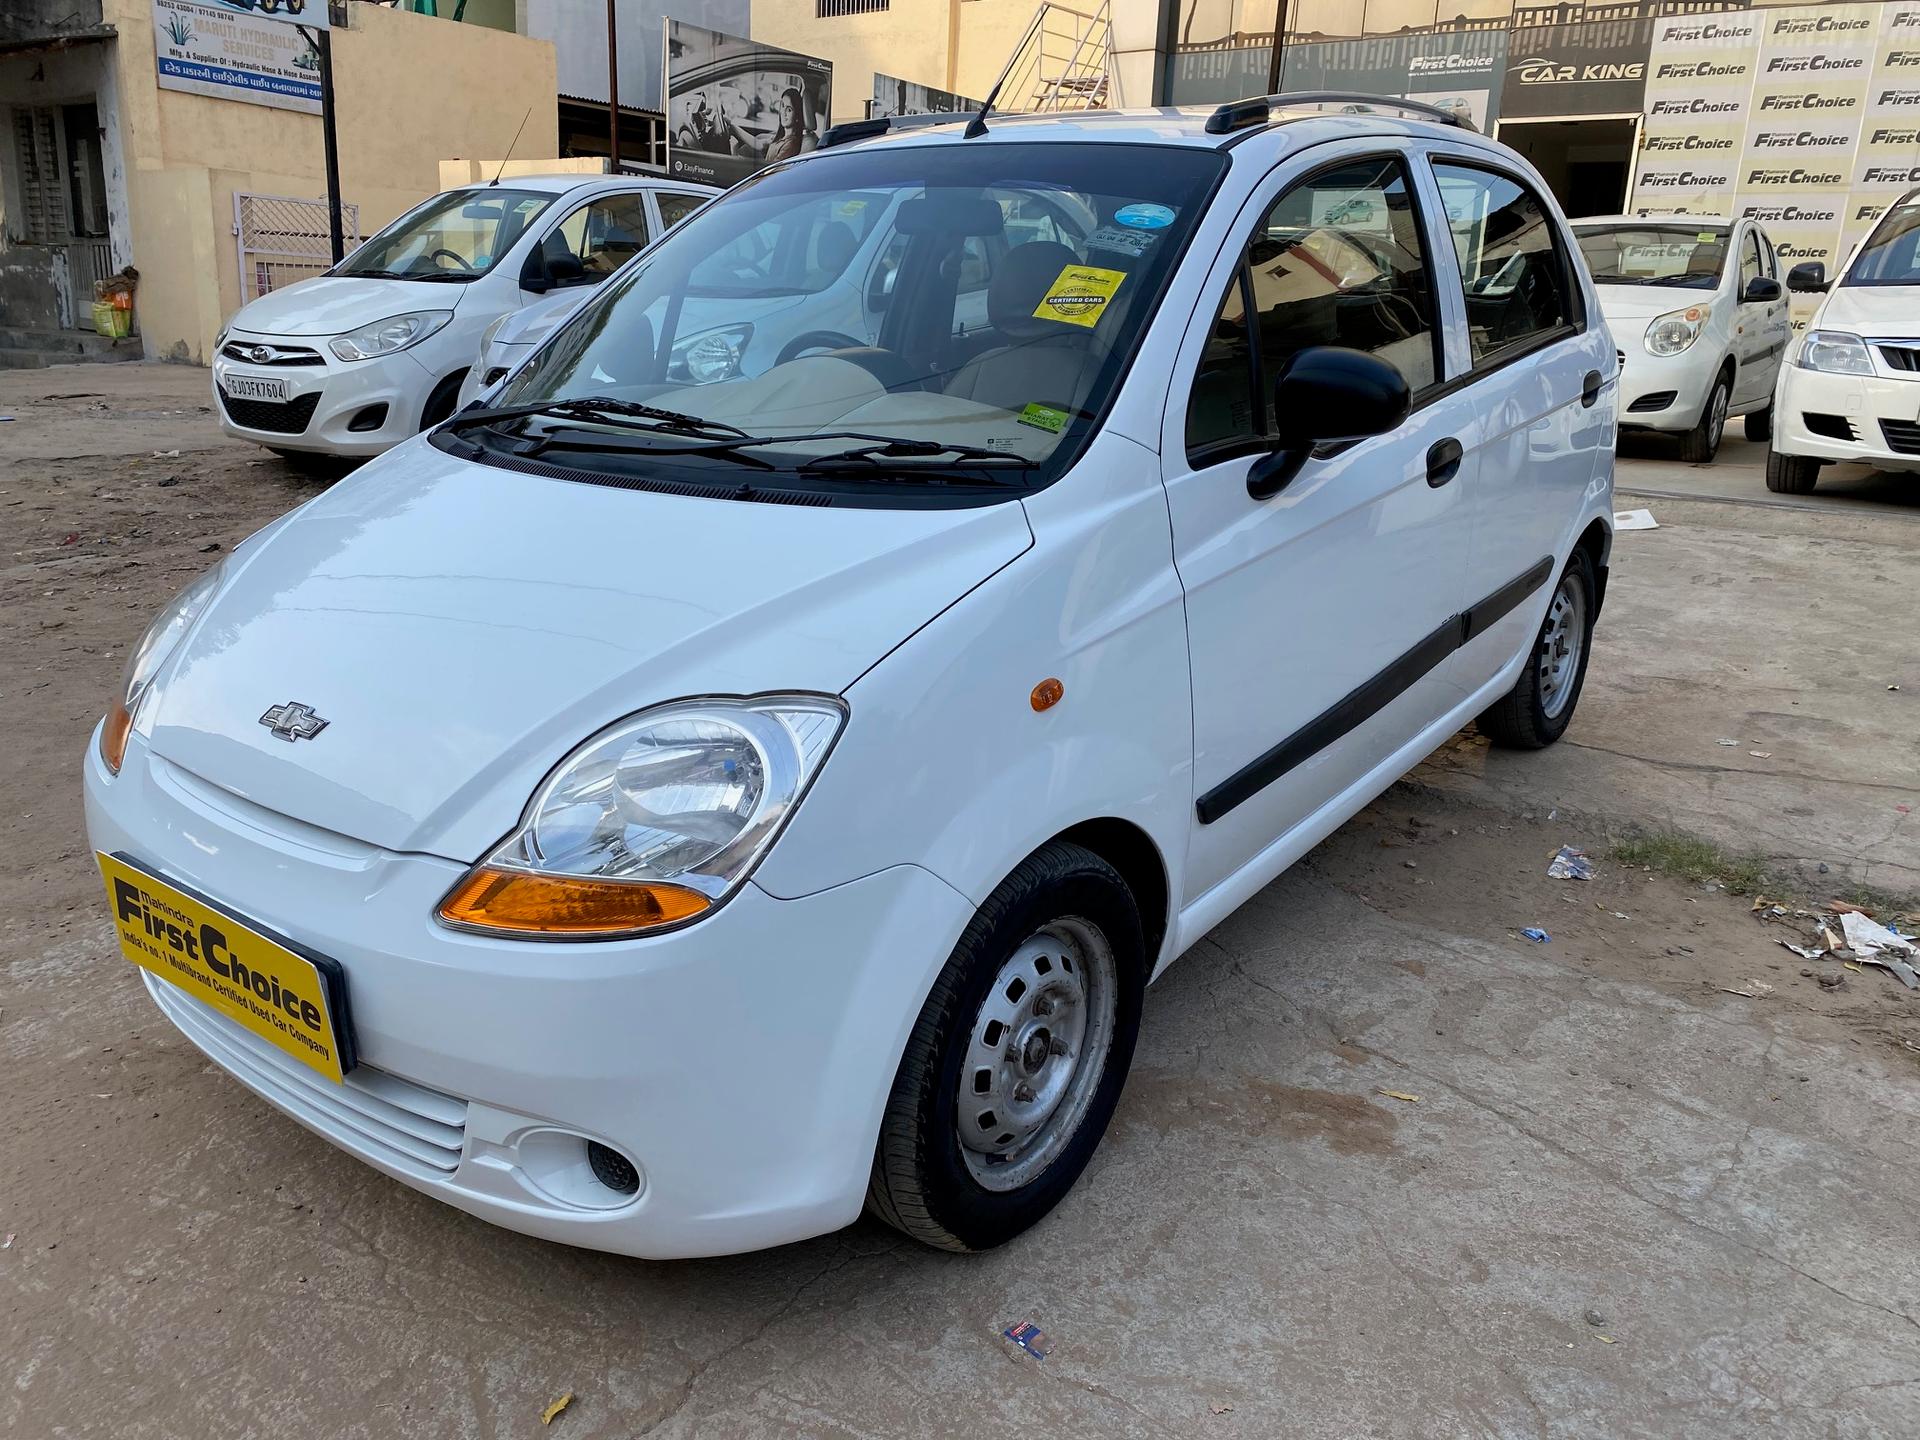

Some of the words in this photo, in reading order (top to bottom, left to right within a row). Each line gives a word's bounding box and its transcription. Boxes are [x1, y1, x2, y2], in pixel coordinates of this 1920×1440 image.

[223, 38, 274, 61] SERVICES
[240, 27, 298, 51] HYDRAULIC
[1520, 66, 1577, 82] CAR
[1582, 63, 1645, 80] KING
[231, 379, 283, 399] GJ03FK7604
[140, 889, 195, 929] mahindra
[122, 928, 148, 954] India's
[170, 955, 212, 987] Multibrand
[213, 978, 249, 1010] Certified
[249, 999, 271, 1023] Used
[272, 1013, 288, 1032] Car
[289, 1023, 330, 1061] Company
